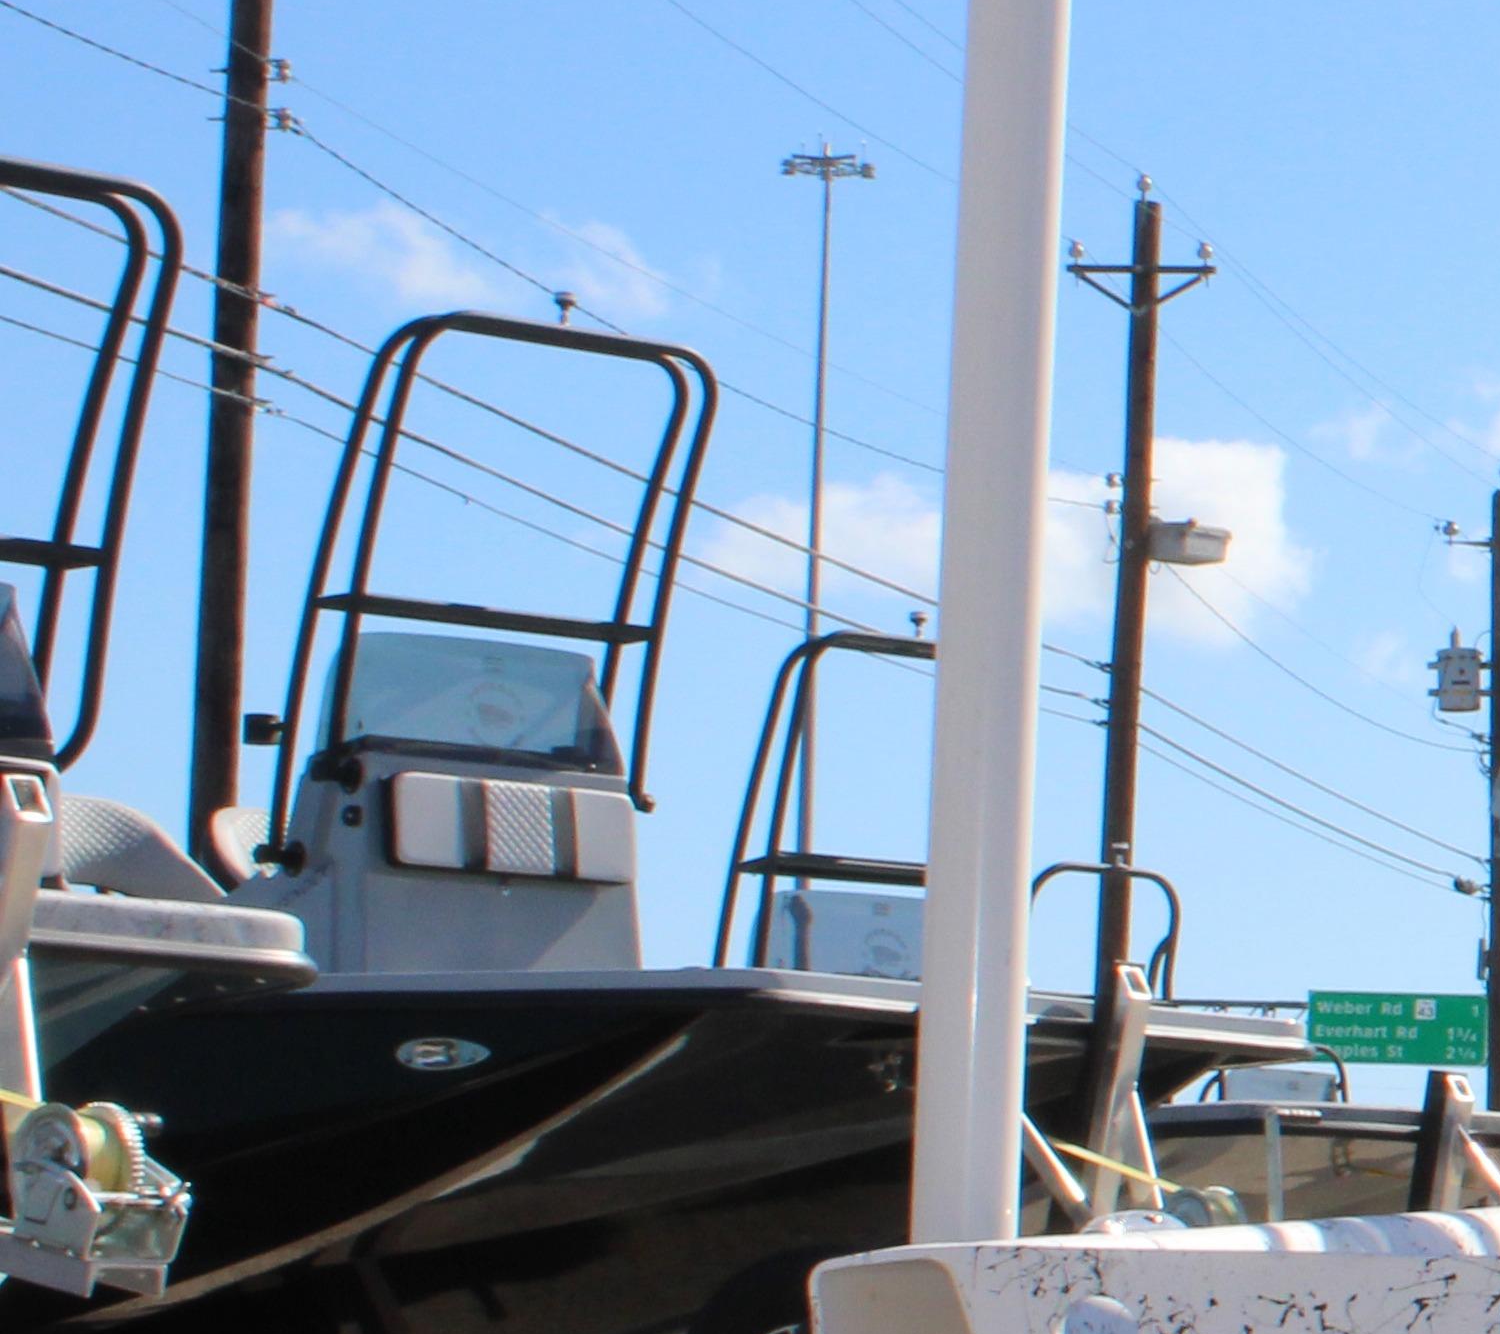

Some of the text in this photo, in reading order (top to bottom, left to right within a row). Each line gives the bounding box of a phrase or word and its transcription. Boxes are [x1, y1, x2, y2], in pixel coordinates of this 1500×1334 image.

[1316, 1001, 1372, 1014] Weber
[1381, 1001, 1403, 1014] Rd
[1314, 1024, 1387, 1038] Everhart
[1395, 1025, 1418, 1039] Rd
[1330, 1043, 1378, 1059] aples
[1387, 1044, 1403, 1058] St
